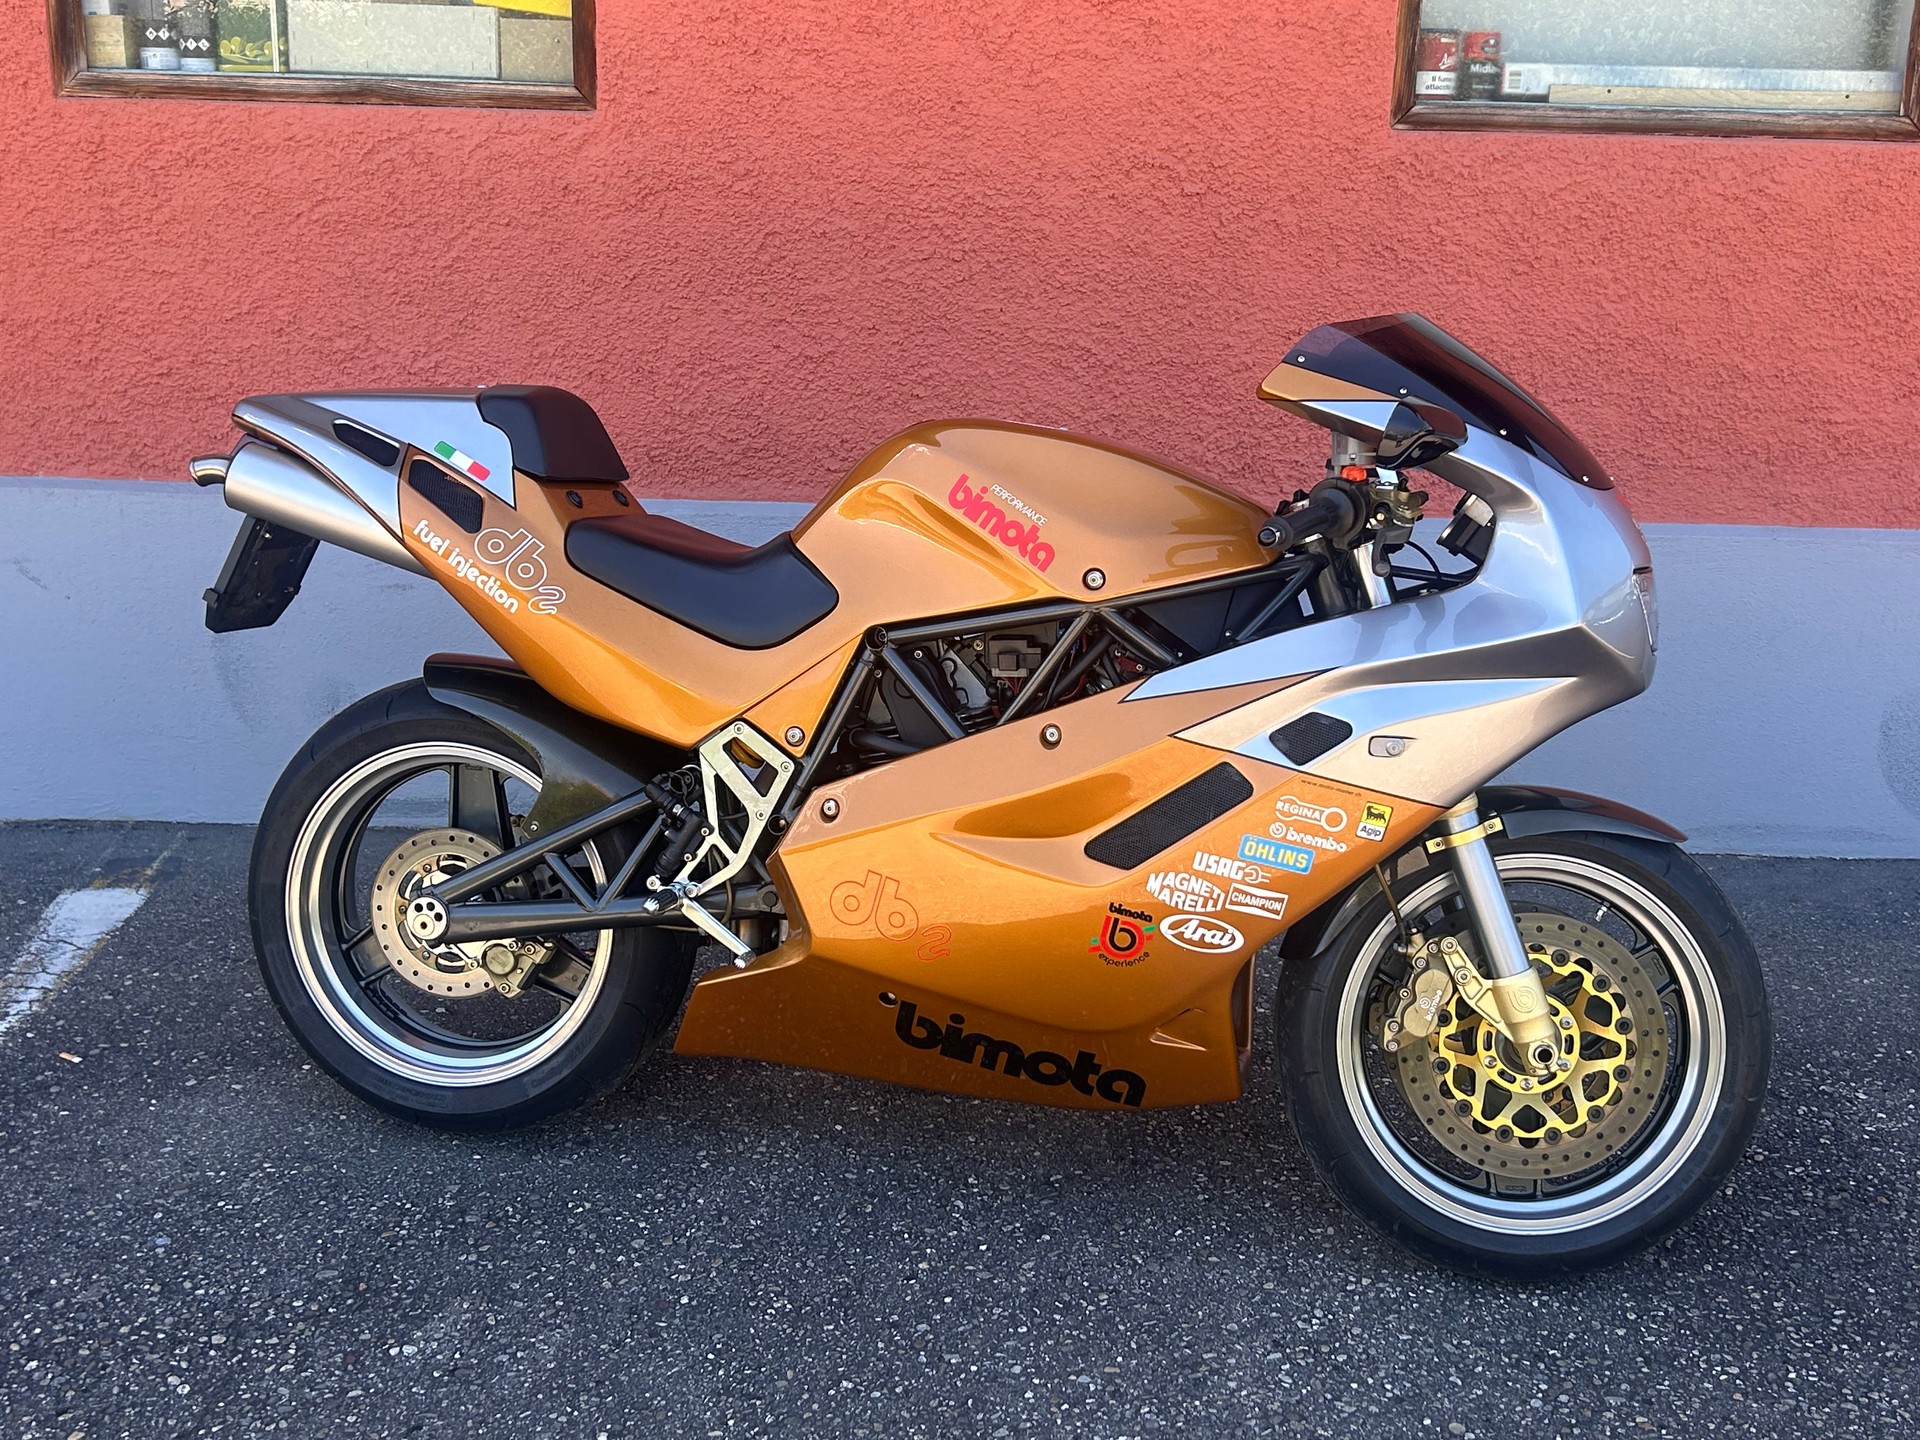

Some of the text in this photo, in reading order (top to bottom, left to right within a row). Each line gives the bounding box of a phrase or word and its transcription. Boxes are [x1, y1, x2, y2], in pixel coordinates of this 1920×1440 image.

[990, 484, 1048, 527] PERFORMANCE
[948, 473, 1055, 573] bimota
[413, 519, 519, 614] fuel injection
[1276, 801, 1321, 820] REGINA
[1286, 826, 1347, 853] brembo
[1360, 825, 1382, 838] Agip
[1192, 851, 1247, 881] USAG
[1243, 836, 1309, 869] ÖHLINS
[1146, 871, 1225, 905] MAGNETI
[1146, 879, 1225, 913] MARELLI
[1231, 891, 1283, 912] CHAMPION
[1108, 902, 1153, 924] bimota
[1165, 918, 1235, 946] Arai
[1098, 951, 1151, 968] experience
[895, 1000, 1148, 1108] bimota
